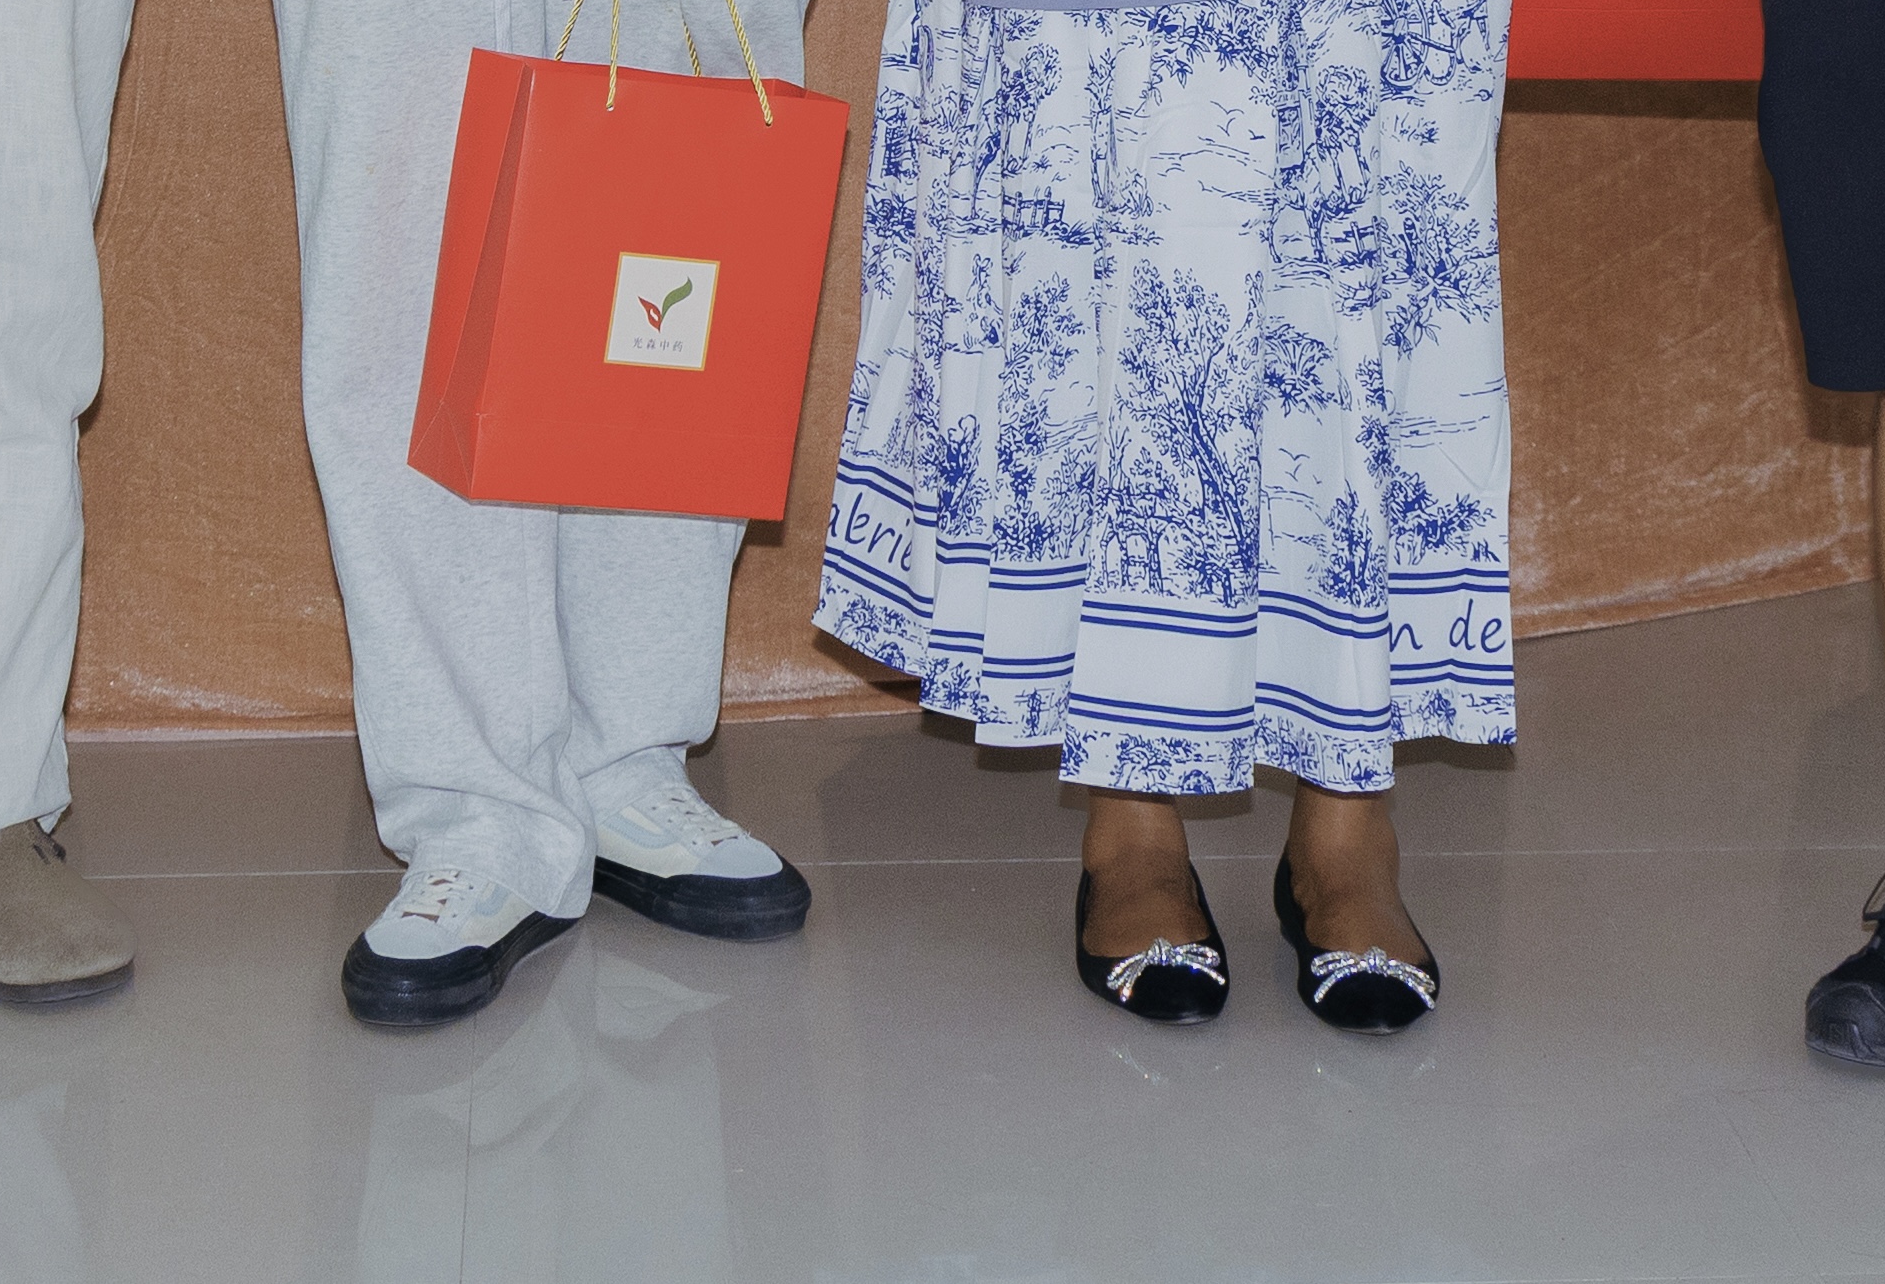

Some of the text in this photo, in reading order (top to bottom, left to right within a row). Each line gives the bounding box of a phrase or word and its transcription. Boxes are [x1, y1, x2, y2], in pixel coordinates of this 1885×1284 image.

[632, 336, 684, 353] 光森中药
[1449, 597, 1507, 653] de
